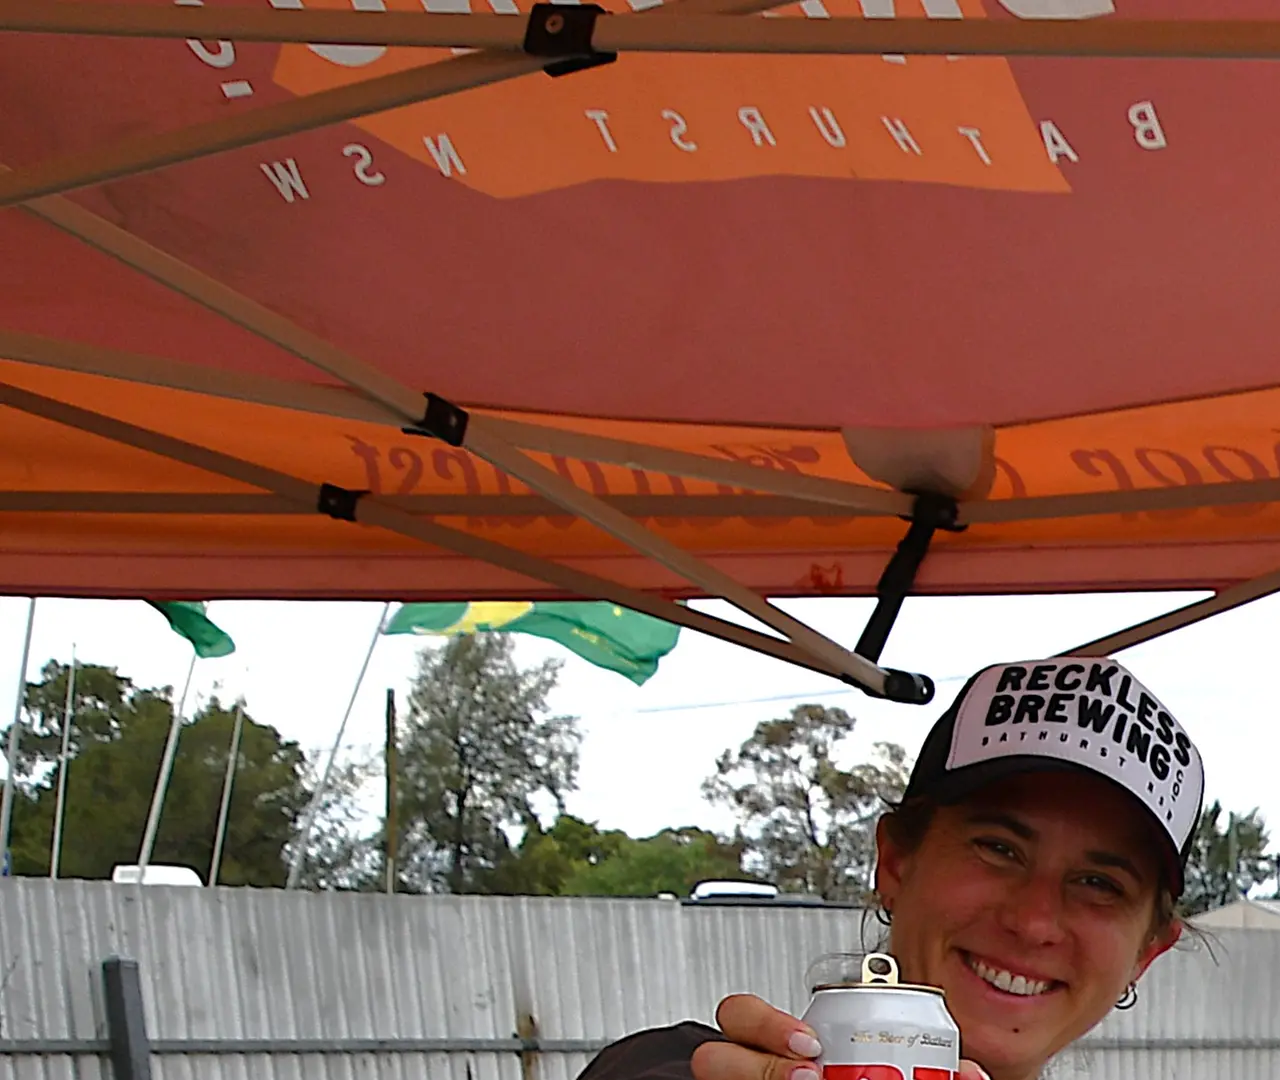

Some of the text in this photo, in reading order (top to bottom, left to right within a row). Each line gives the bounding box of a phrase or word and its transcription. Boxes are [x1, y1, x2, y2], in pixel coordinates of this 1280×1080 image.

[981, 731, 1128, 768] BATHURST
[984, 694, 1171, 782] BREWING
[997, 663, 1191, 768] RECKLESS
